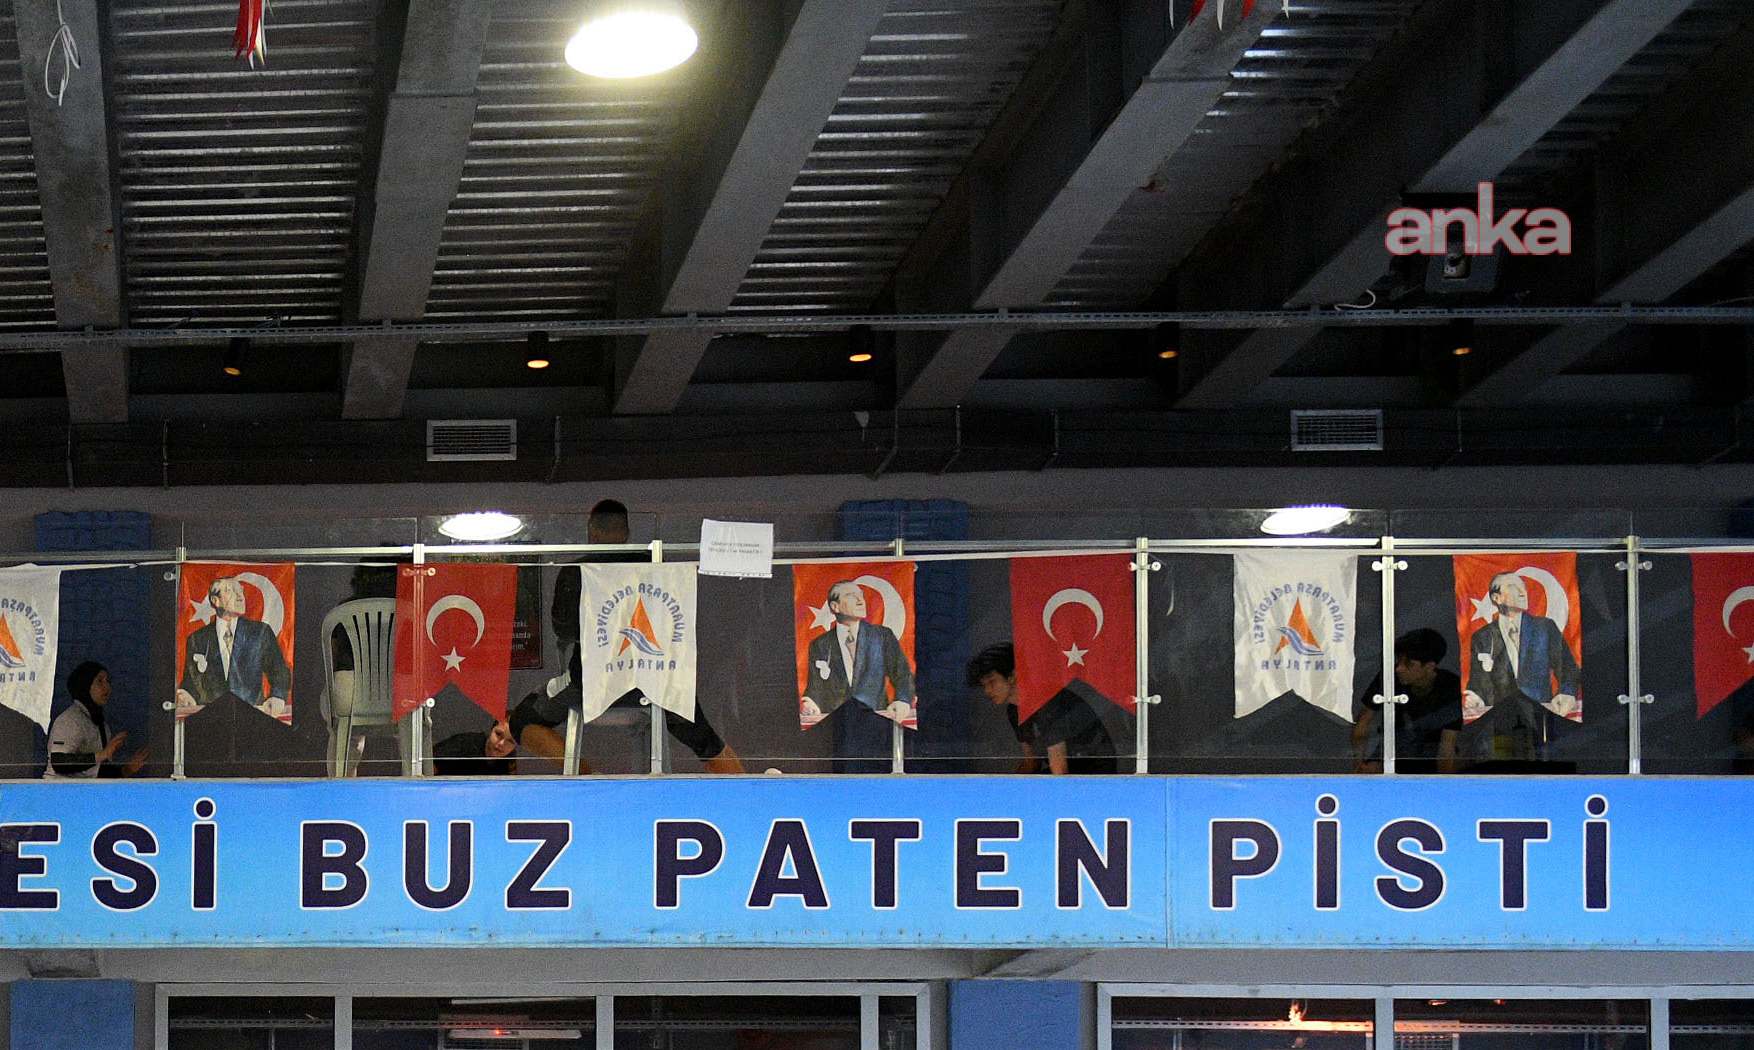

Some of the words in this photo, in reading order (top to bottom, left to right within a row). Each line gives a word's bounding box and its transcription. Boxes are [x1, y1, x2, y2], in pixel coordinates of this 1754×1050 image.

[300, 820, 572, 911] BUZ
[654, 819, 1130, 910] PATEN
[1210, 795, 1609, 911] PİSTİ
